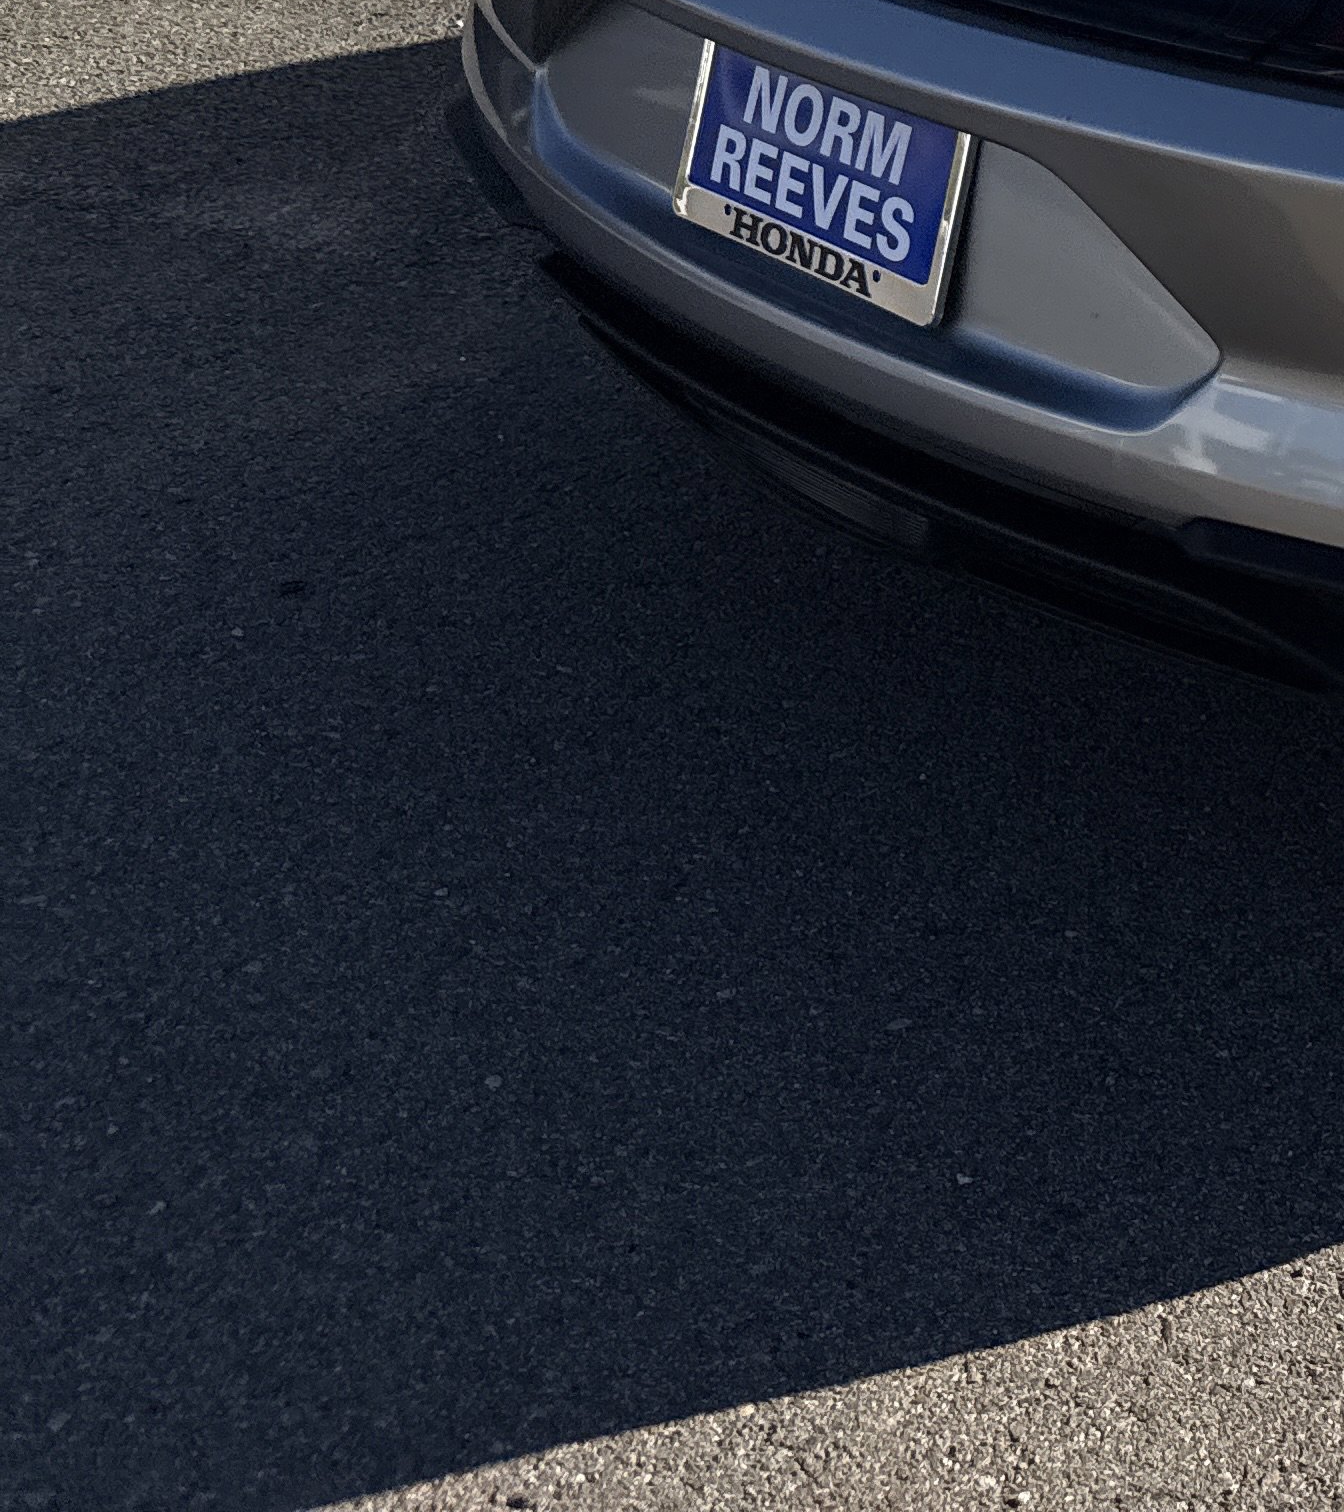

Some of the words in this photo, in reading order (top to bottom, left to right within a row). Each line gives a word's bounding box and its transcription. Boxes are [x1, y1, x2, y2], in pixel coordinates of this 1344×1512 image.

[743, 65, 913, 186] NORM
[710, 123, 915, 263] REEVES
[729, 205, 872, 298] HONDA
